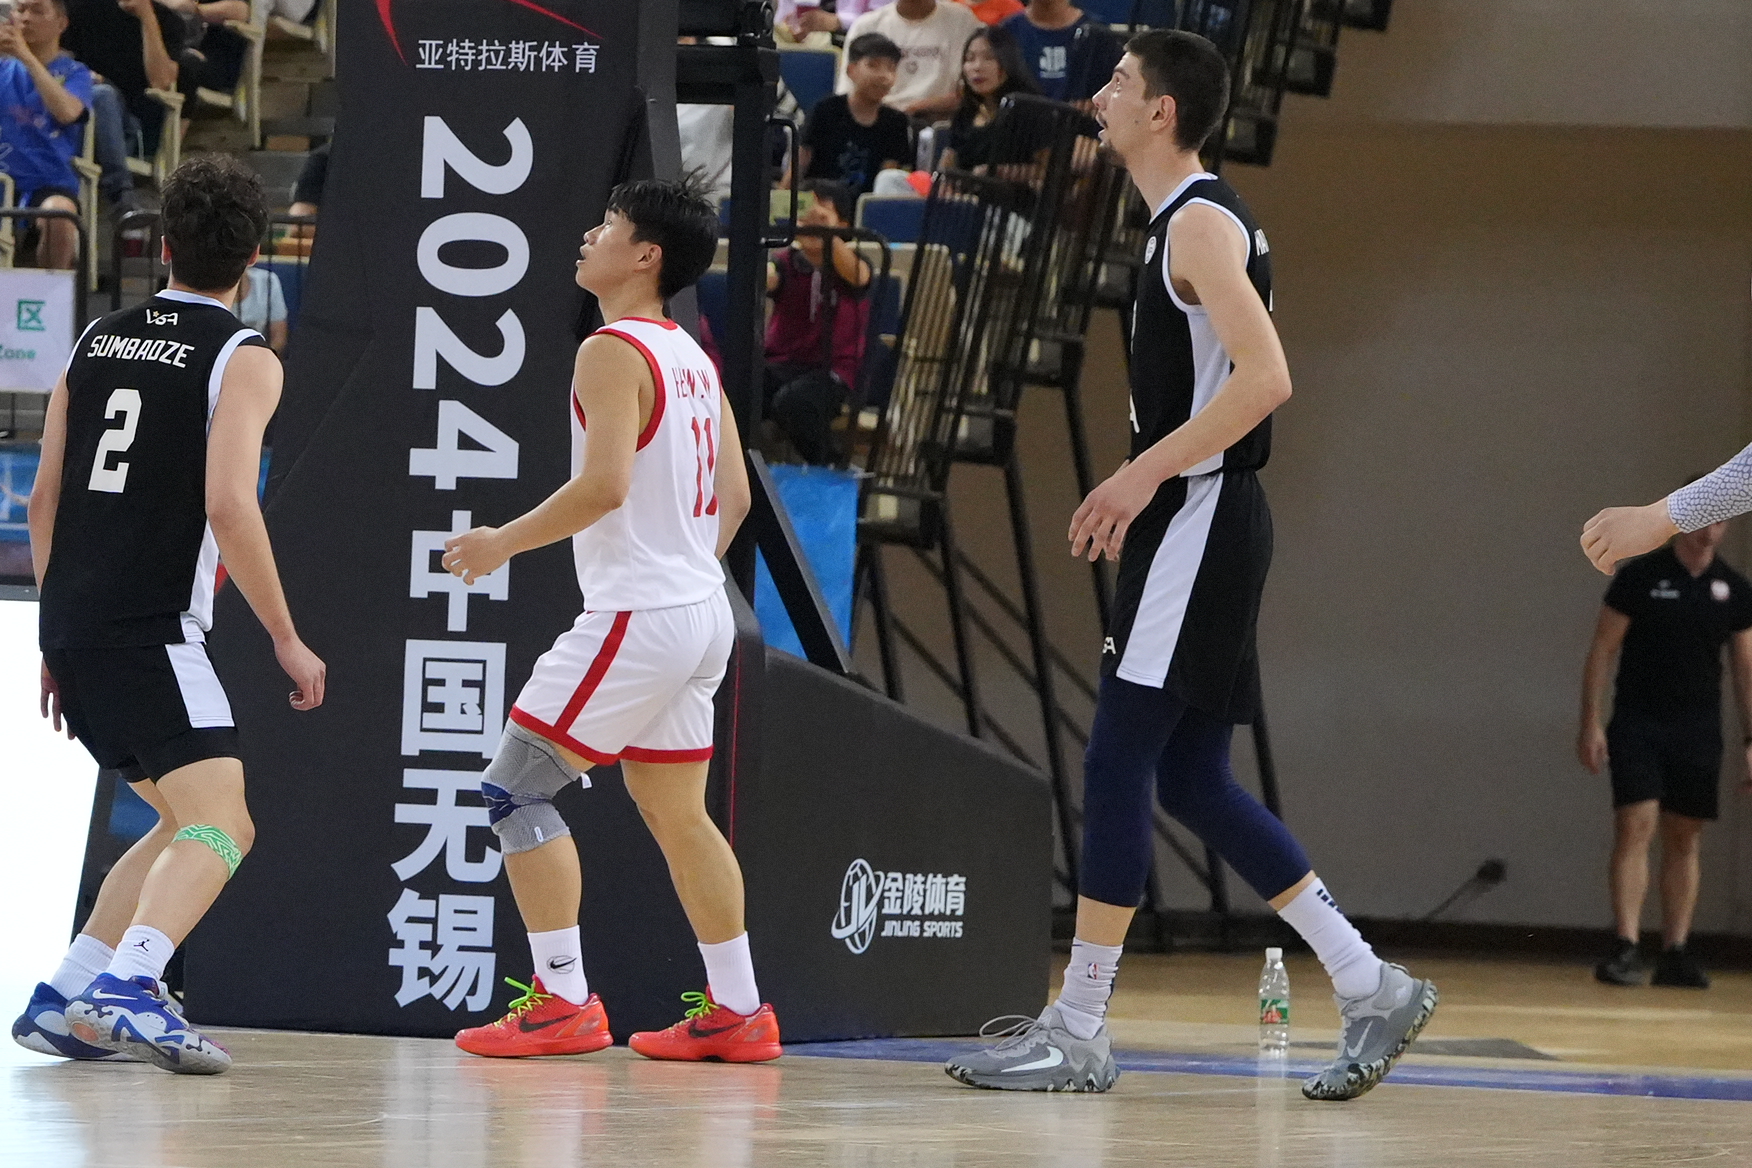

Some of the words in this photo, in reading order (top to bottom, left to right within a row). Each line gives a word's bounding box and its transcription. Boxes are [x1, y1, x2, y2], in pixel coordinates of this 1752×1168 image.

[416, 39, 600, 73] 亚特拉斯体育
[87, 334, 195, 369] SUMBADZE
[88, 388, 142, 494] 2
[691, 416, 720, 518] 11
[881, 872, 967, 916] 金陵体育
[880, 920, 921, 937] JINLING
[922, 921, 964, 938] SPORTS
